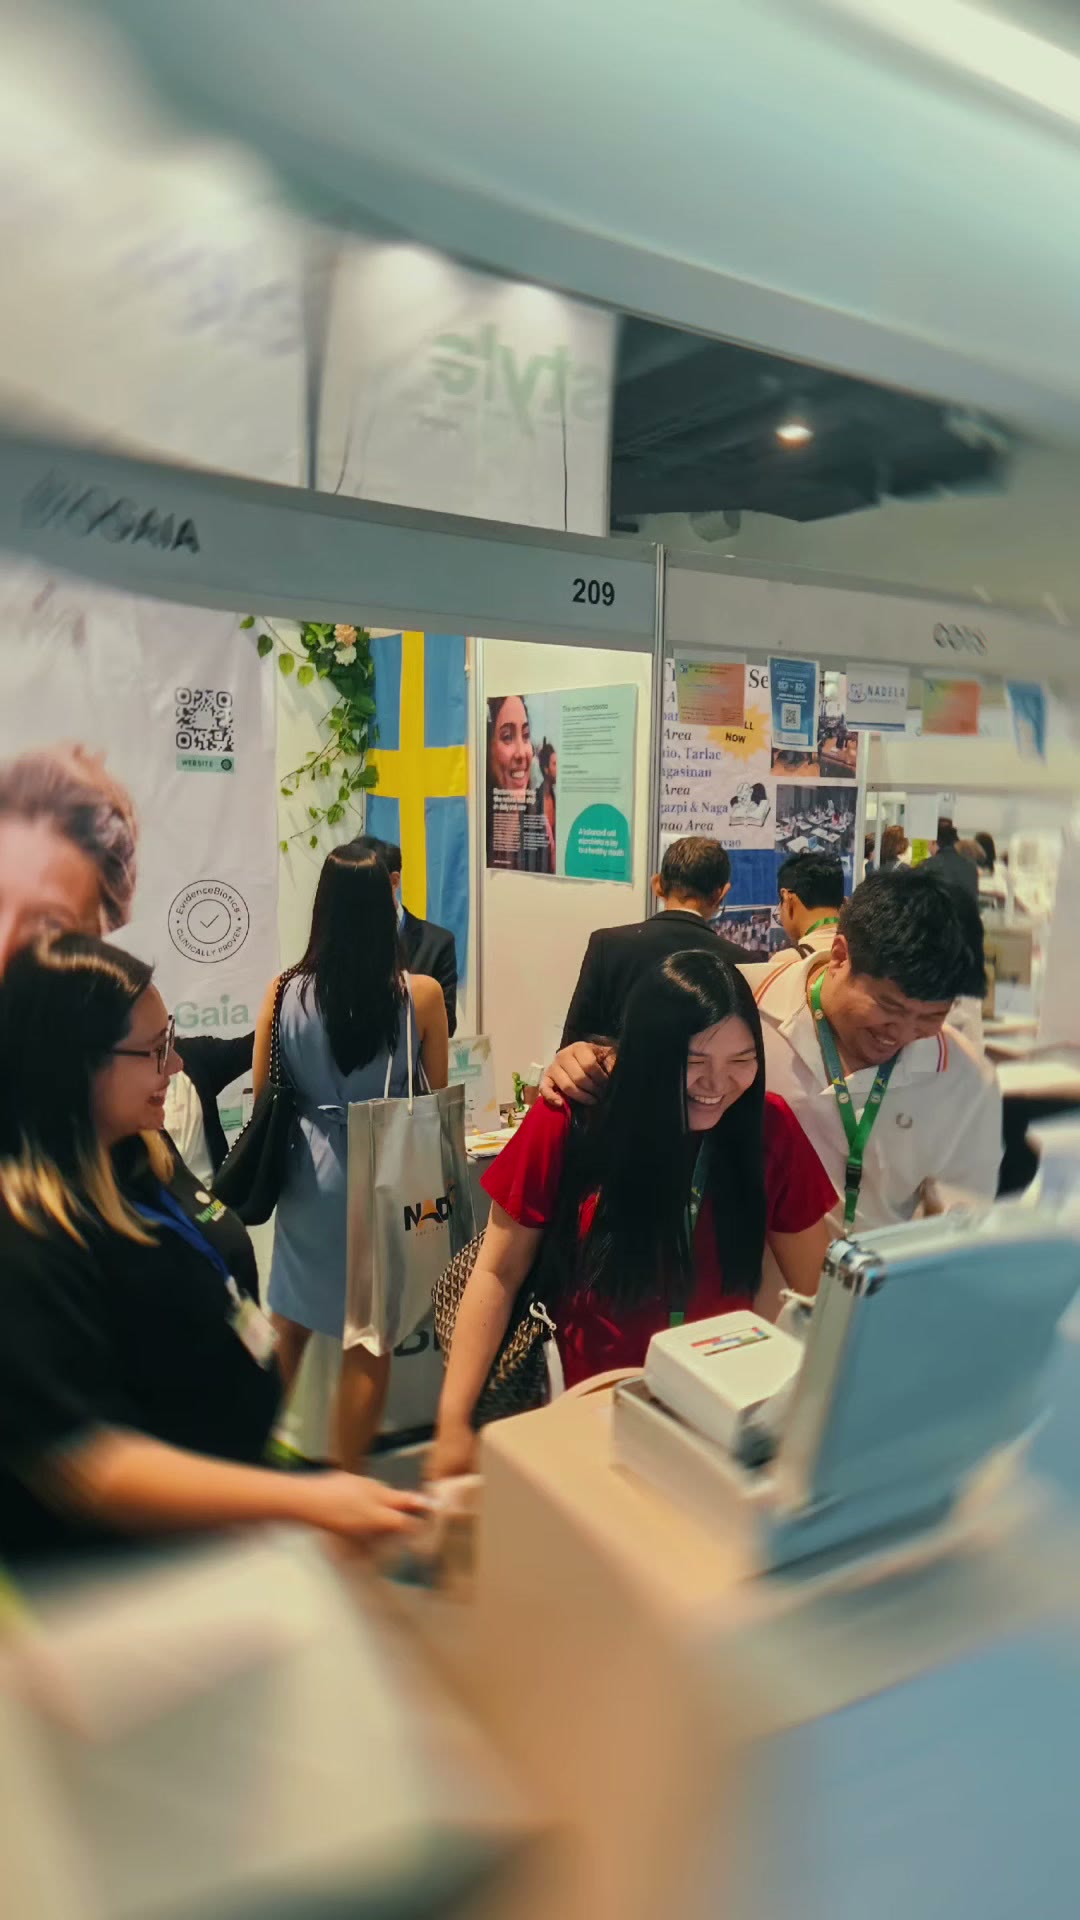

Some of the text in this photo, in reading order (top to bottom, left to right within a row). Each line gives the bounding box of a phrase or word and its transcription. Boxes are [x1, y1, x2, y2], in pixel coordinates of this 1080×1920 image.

[573, 578, 615, 606] 209
[749, 669, 769, 688] Se
[664, 728, 692, 740] Area
[725, 732, 746, 743] NOW
[685, 747, 721, 760] Tarlac
[664, 784, 690, 795] Area
[702, 801, 728, 816] Naga
[686, 820, 713, 831] Area
[176, 887, 240, 915] EvidenceBiotics
[177, 926, 241, 956] CLINICALLY PROVEN
[175, 994, 249, 1029] Gaia
